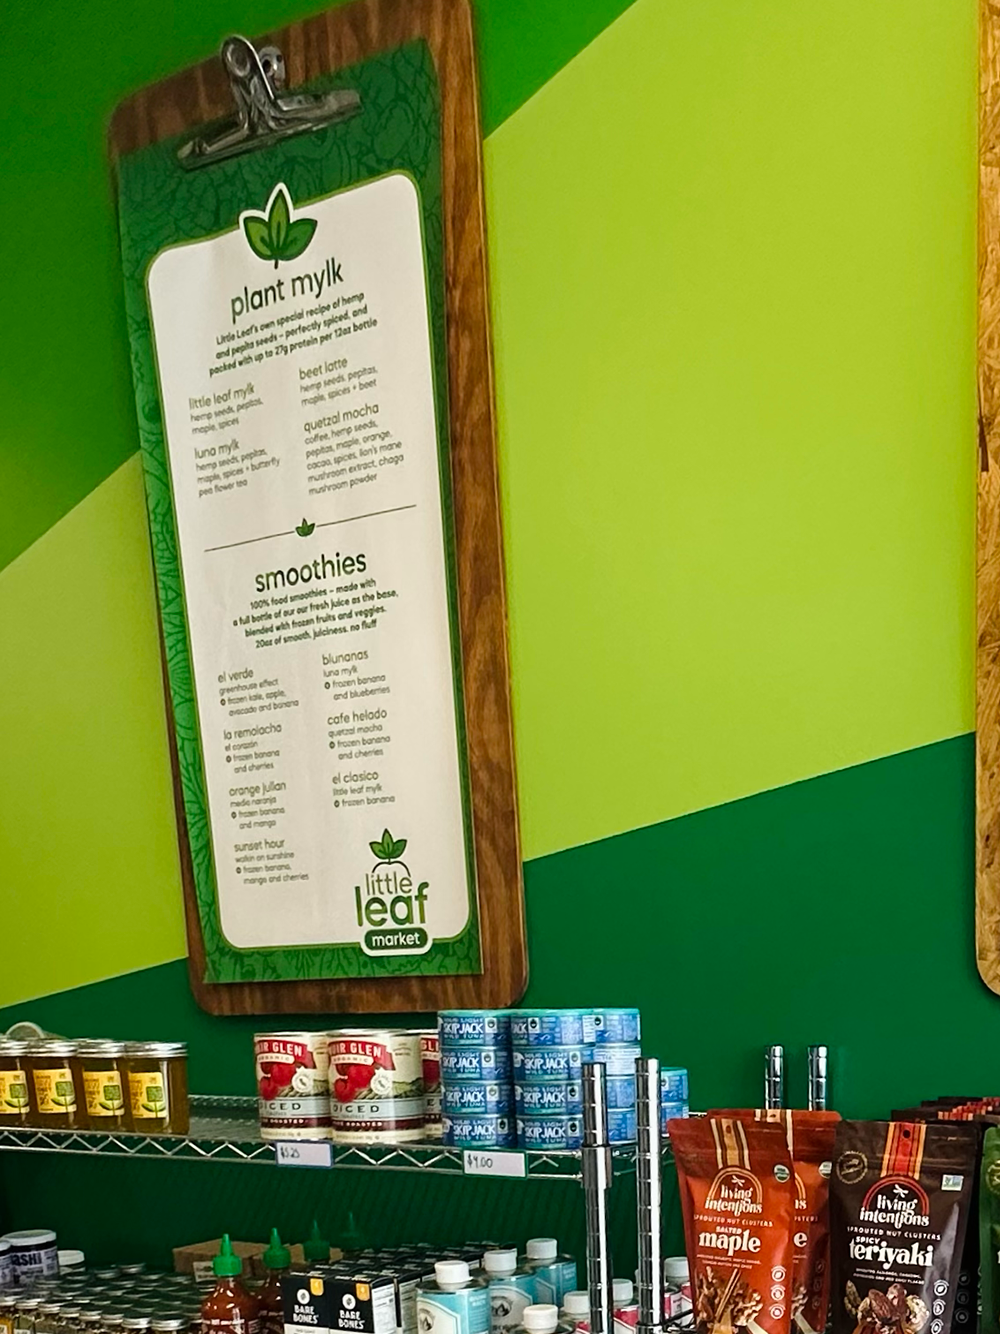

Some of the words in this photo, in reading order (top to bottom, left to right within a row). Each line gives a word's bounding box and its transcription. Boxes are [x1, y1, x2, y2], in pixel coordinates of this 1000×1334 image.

[230, 278, 286, 326] plant
[290, 256, 344, 300] mylk
[298, 364, 324, 381] beet
[324, 357, 349, 374] latte
[303, 410, 341, 435] quetzal
[342, 402, 380, 422] mocha
[254, 551, 367, 593] smoothies
[321, 649, 370, 666] blunanas
[326, 711, 351, 726] cafe
[351, 707, 388, 723] helado
[331, 771, 342, 785] el
[342, 769, 380, 784] clasico
[365, 872, 412, 894] little
[354, 881, 429, 927] leaf
[371, 932, 420, 947] market
[350, 1043, 382, 1057] GLEN
[720, 1185, 753, 1201] living
[705, 1198, 762, 1216] intentions
[877, 1195, 918, 1214] living
[859, 1208, 930, 1228] intentions
[698, 1227, 761, 1256] maple
[855, 1236, 880, 1245] SPICY
[849, 1240, 933, 1270] teriyaki
